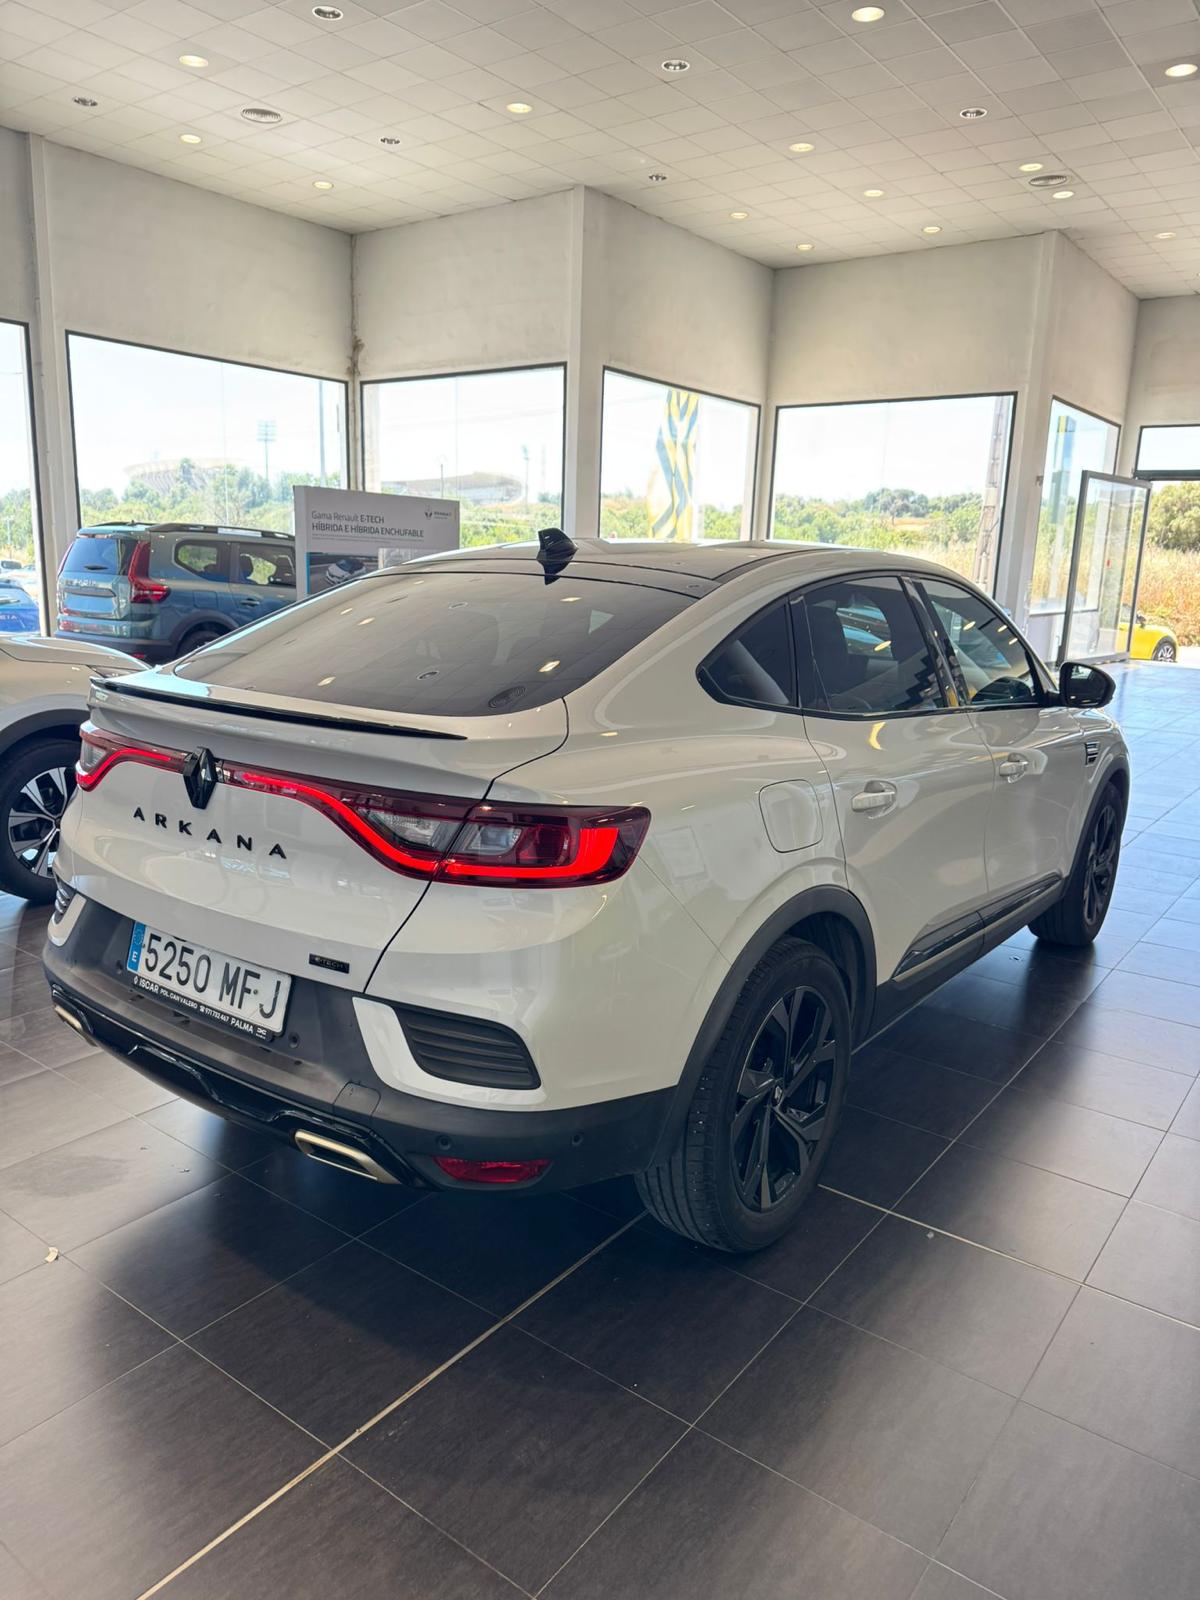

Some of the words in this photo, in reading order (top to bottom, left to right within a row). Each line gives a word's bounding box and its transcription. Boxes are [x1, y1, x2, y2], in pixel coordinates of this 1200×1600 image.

[311, 510, 333, 521] Gama
[333, 512, 359, 523] Renault
[360, 514, 385, 524] E-TECH
[312, 522, 344, 532] HÍBRIDA
[345, 524, 350, 533] E
[350, 524, 380, 535] HÍBRIDA
[381, 527, 424, 538] ENCHUFABLE
[133, 807, 287, 860] ARKANA
[144, 933, 212, 994] 5250
[139, 979, 159, 994] ISCAR
[230, 1018, 253, 1034] PALMA
